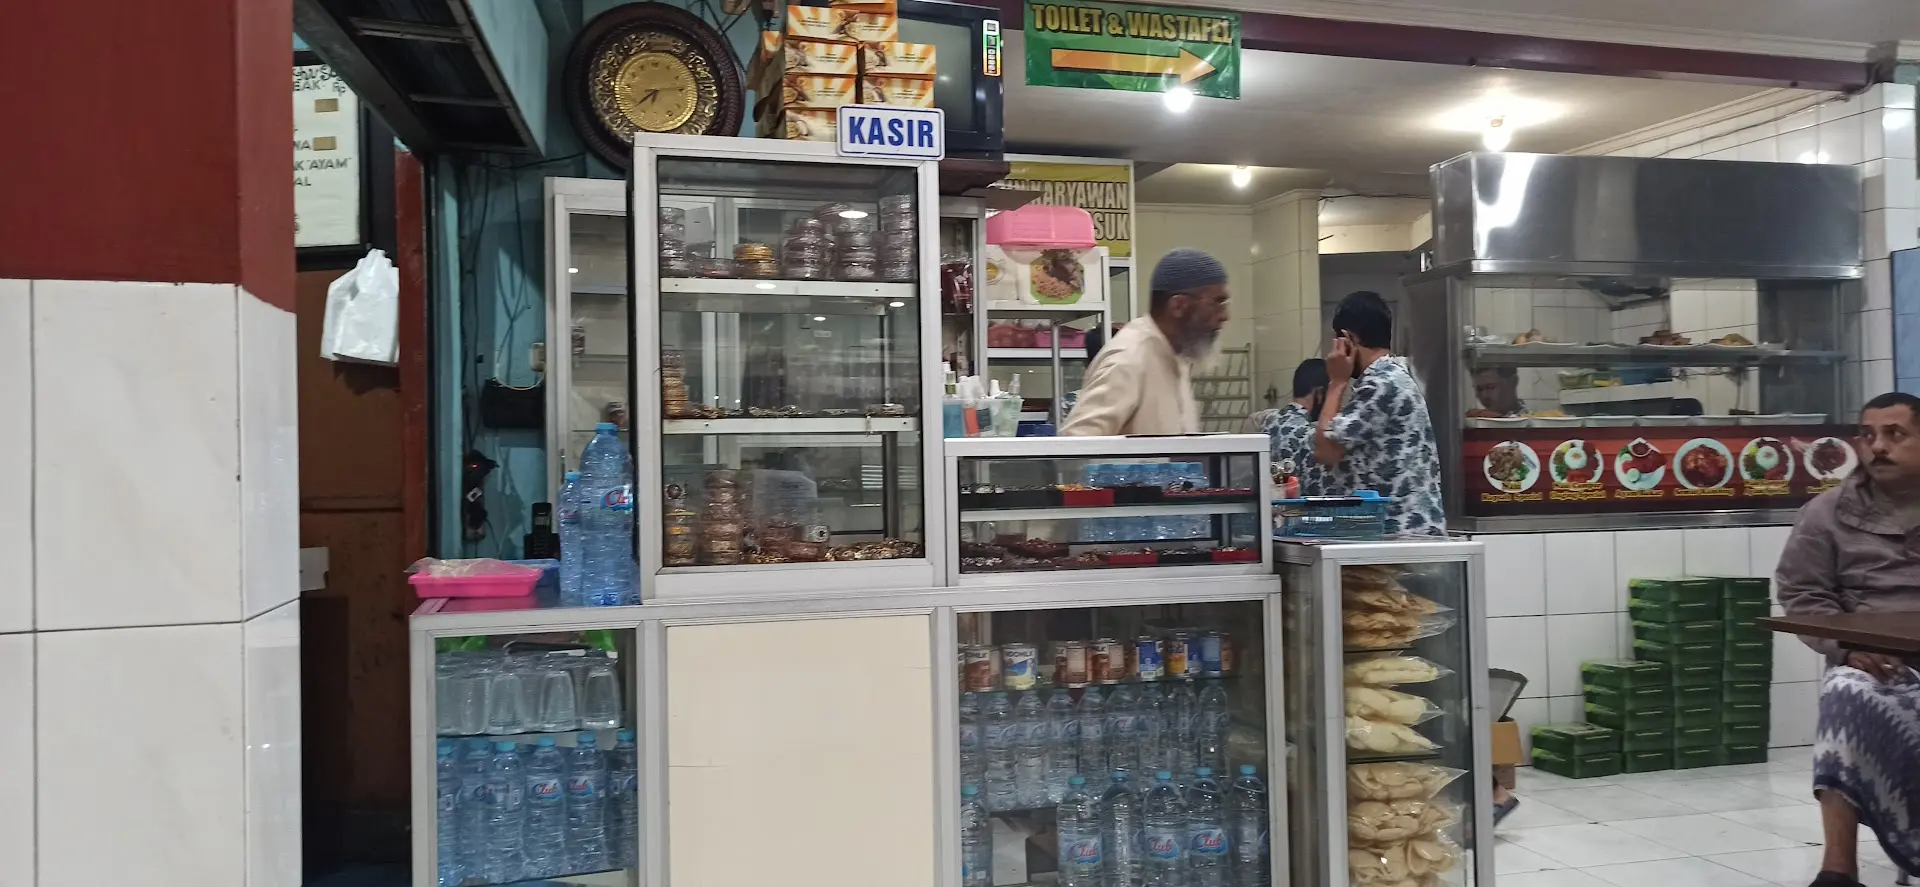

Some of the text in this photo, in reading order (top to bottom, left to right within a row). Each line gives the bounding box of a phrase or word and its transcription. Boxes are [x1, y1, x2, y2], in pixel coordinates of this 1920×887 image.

[1032, 4, 1232, 43] TOILET & WASTAFEL
[849, 116, 934, 148] KASIR
[1091, 211, 1130, 240] SUK
